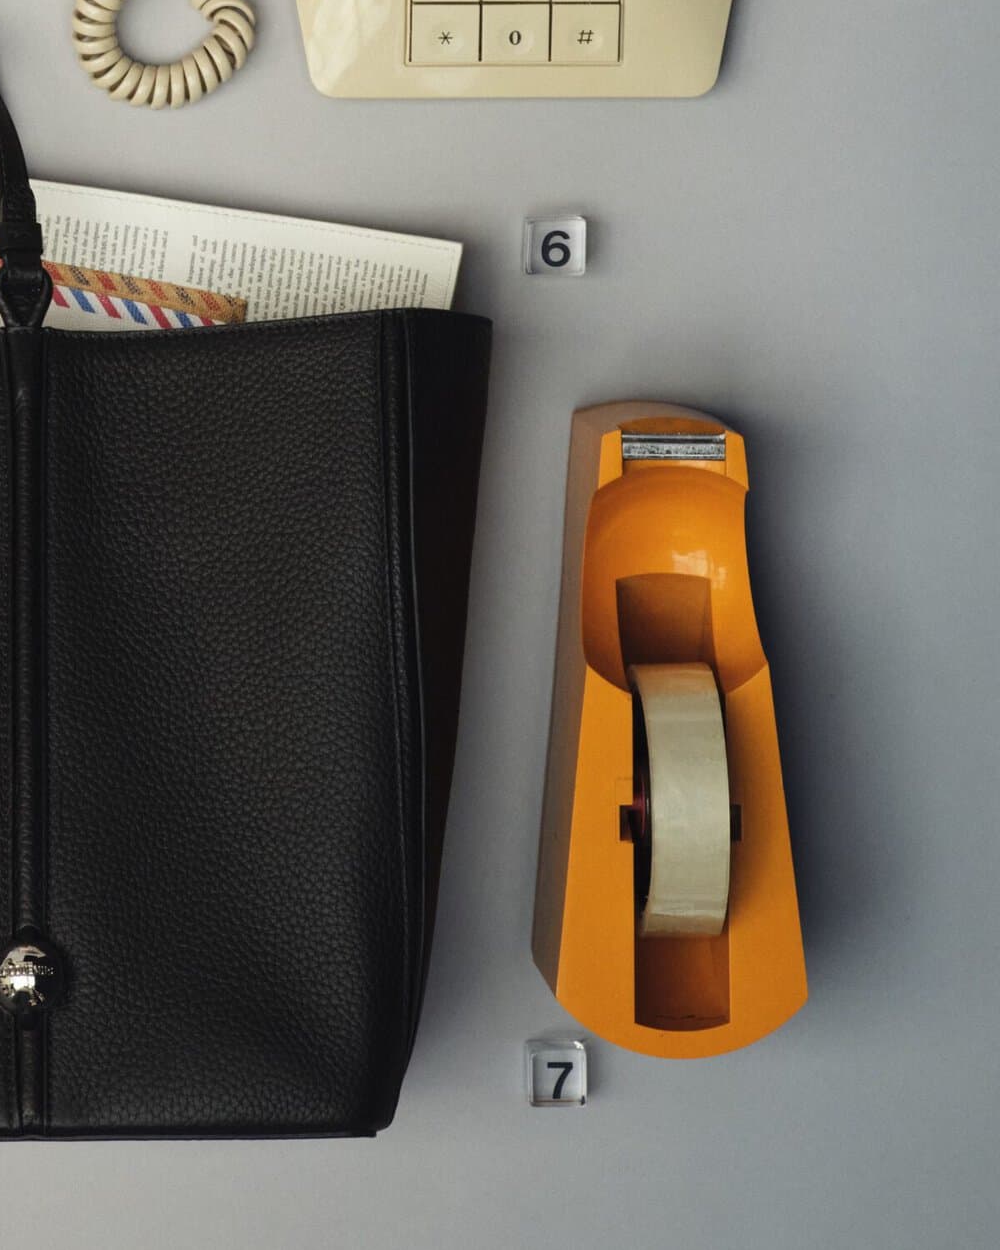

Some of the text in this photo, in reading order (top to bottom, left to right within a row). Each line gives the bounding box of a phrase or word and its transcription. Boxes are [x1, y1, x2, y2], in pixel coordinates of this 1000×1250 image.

[509, 30, 521, 45] 0
[577, 29, 594, 44] #
[542, 231, 571, 267] 6
[547, 1062, 573, 1100] 7
